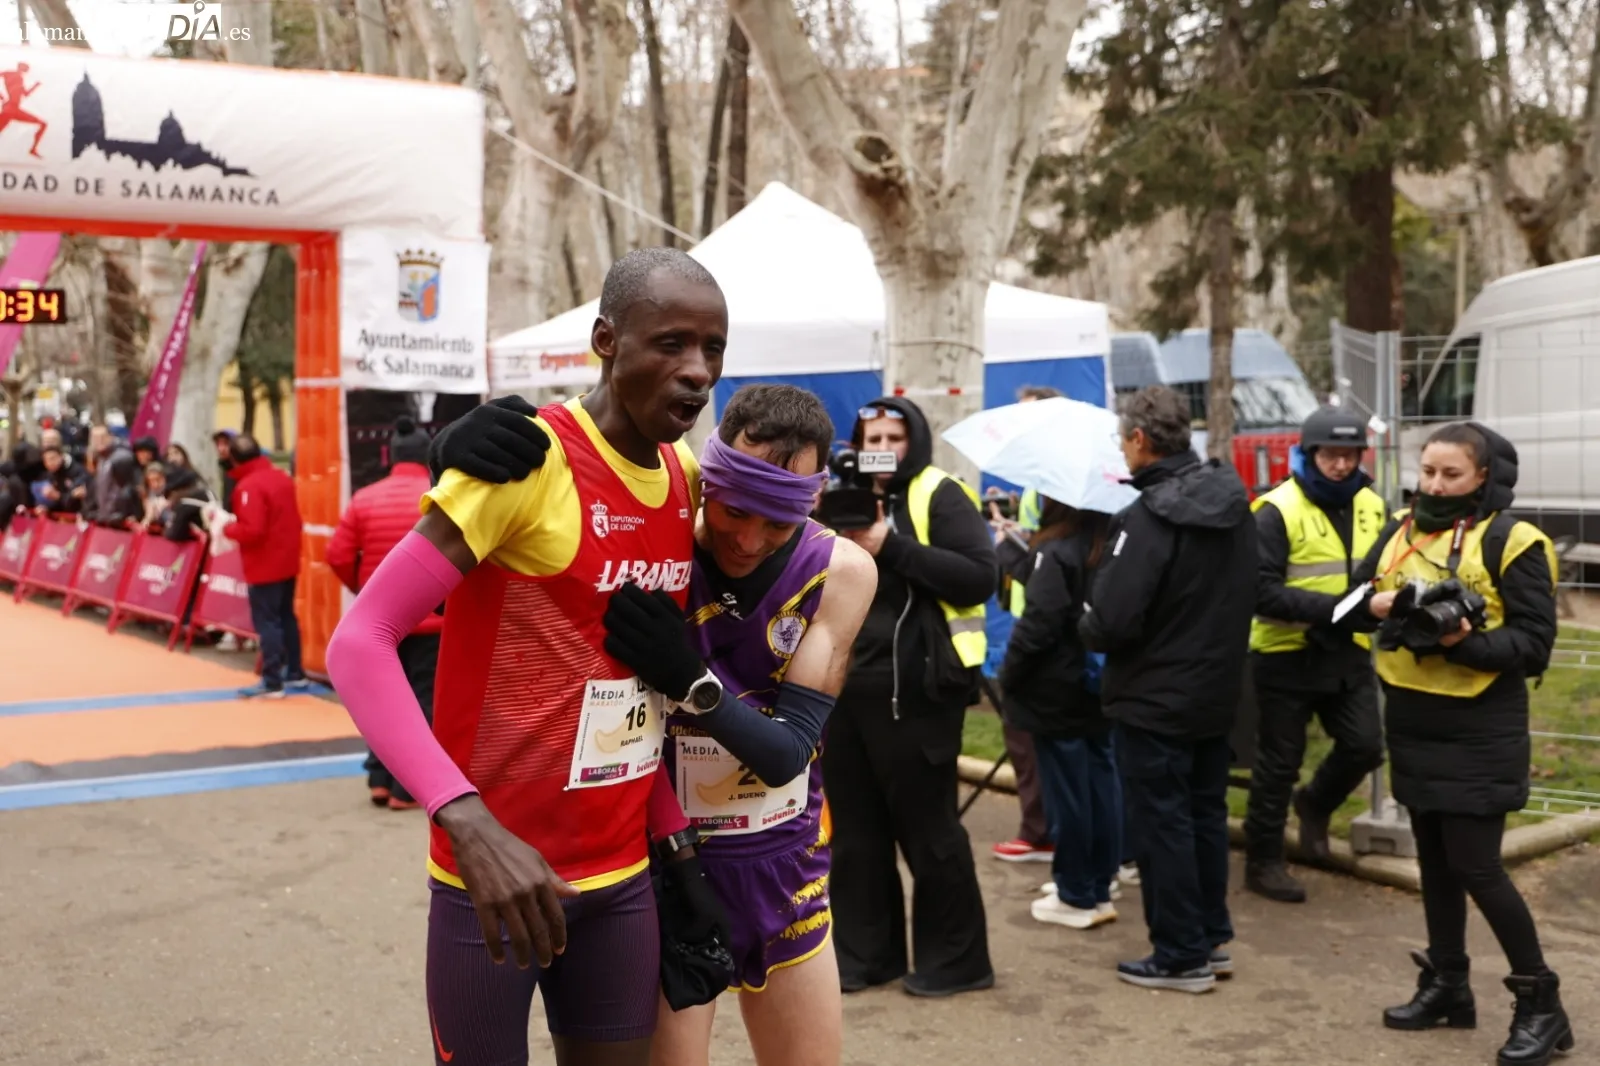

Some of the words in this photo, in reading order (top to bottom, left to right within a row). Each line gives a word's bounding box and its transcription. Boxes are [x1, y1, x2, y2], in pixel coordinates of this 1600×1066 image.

[75, 178, 104, 196] DE
[121, 182, 280, 206] SALAMANCA
[358, 329, 475, 354] Ayuntamiento
[356, 355, 376, 374] de
[383, 355, 475, 379] Salamanca
[610, 523, 620, 531] DE
[620, 523, 636, 531] LEÓN
[591, 690, 624, 699] MEDIA
[625, 702, 646, 731] 16
[620, 736, 644, 747] RAPHAEL
[682, 745, 719, 756] MEDIA
[588, 765, 618, 776] LABORAL
[728, 793, 736, 801] J.
[738, 791, 767, 800] BUENO
[698, 817, 732, 825] LABORAL
